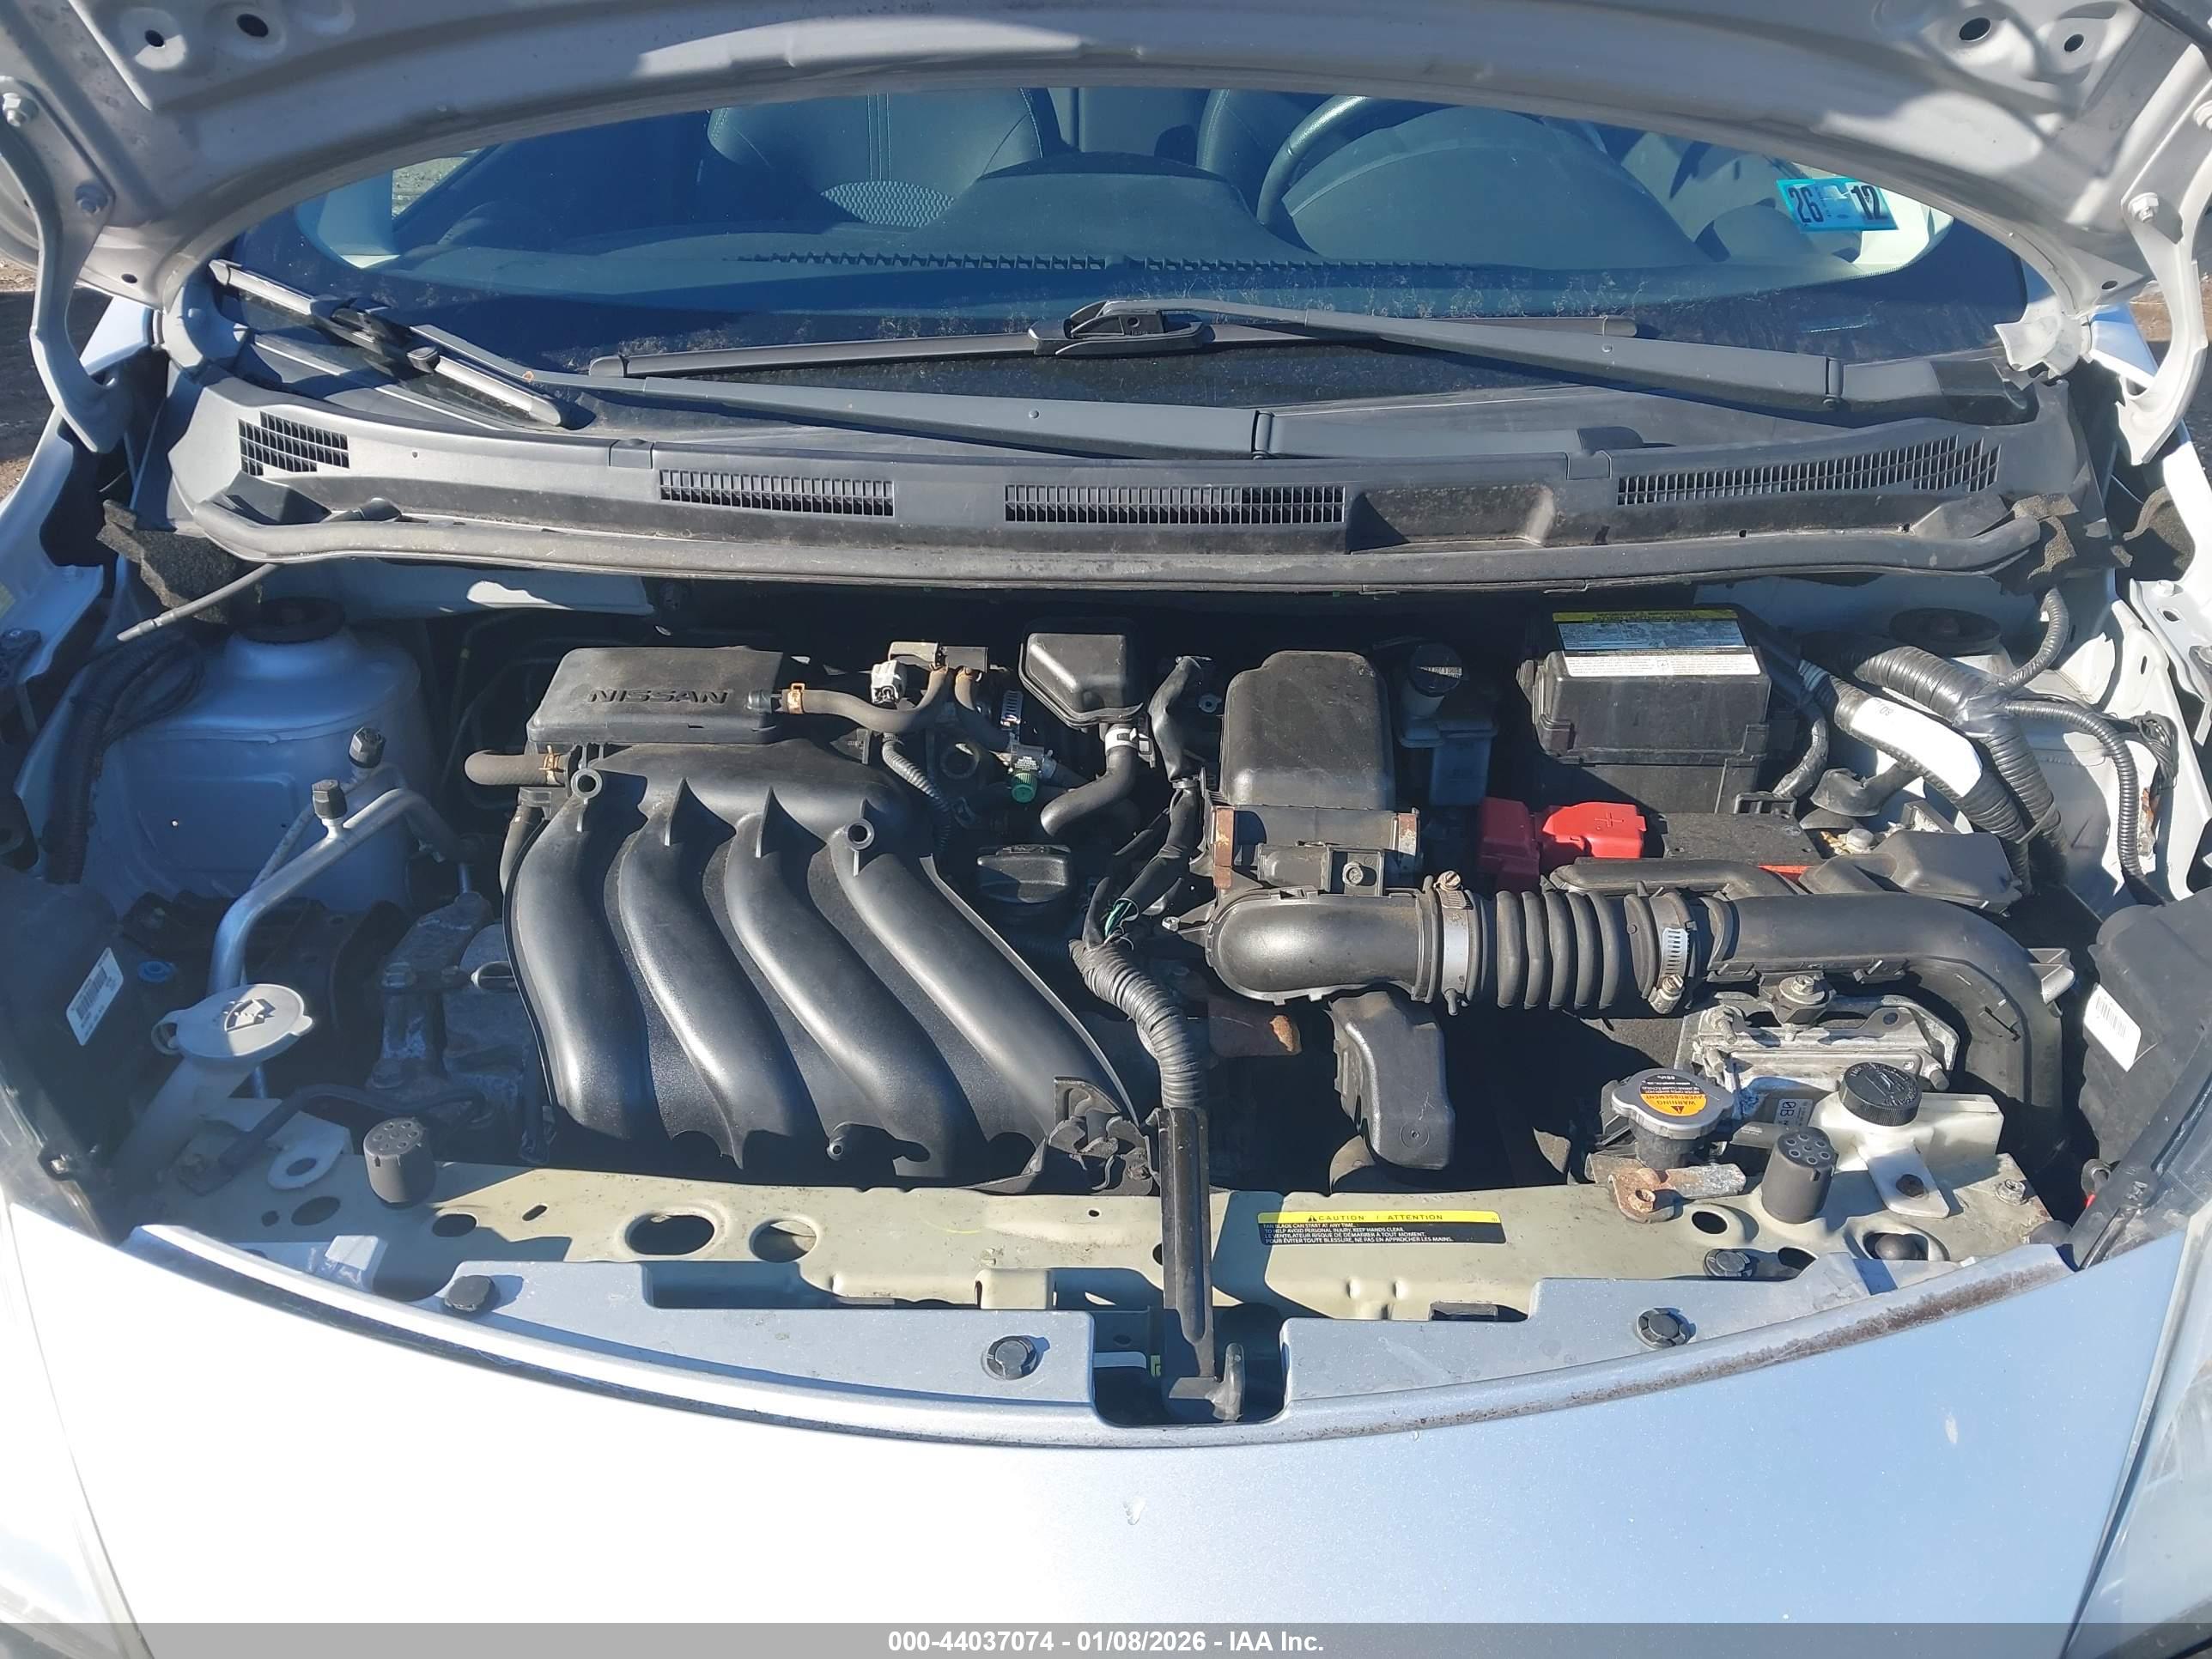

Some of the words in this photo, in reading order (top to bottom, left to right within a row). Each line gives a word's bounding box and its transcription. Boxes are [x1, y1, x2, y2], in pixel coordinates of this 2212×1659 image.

[1788, 186, 1824, 223] 26
[1850, 185, 1888, 220] 12
[587, 690, 729, 704] NISSAN
